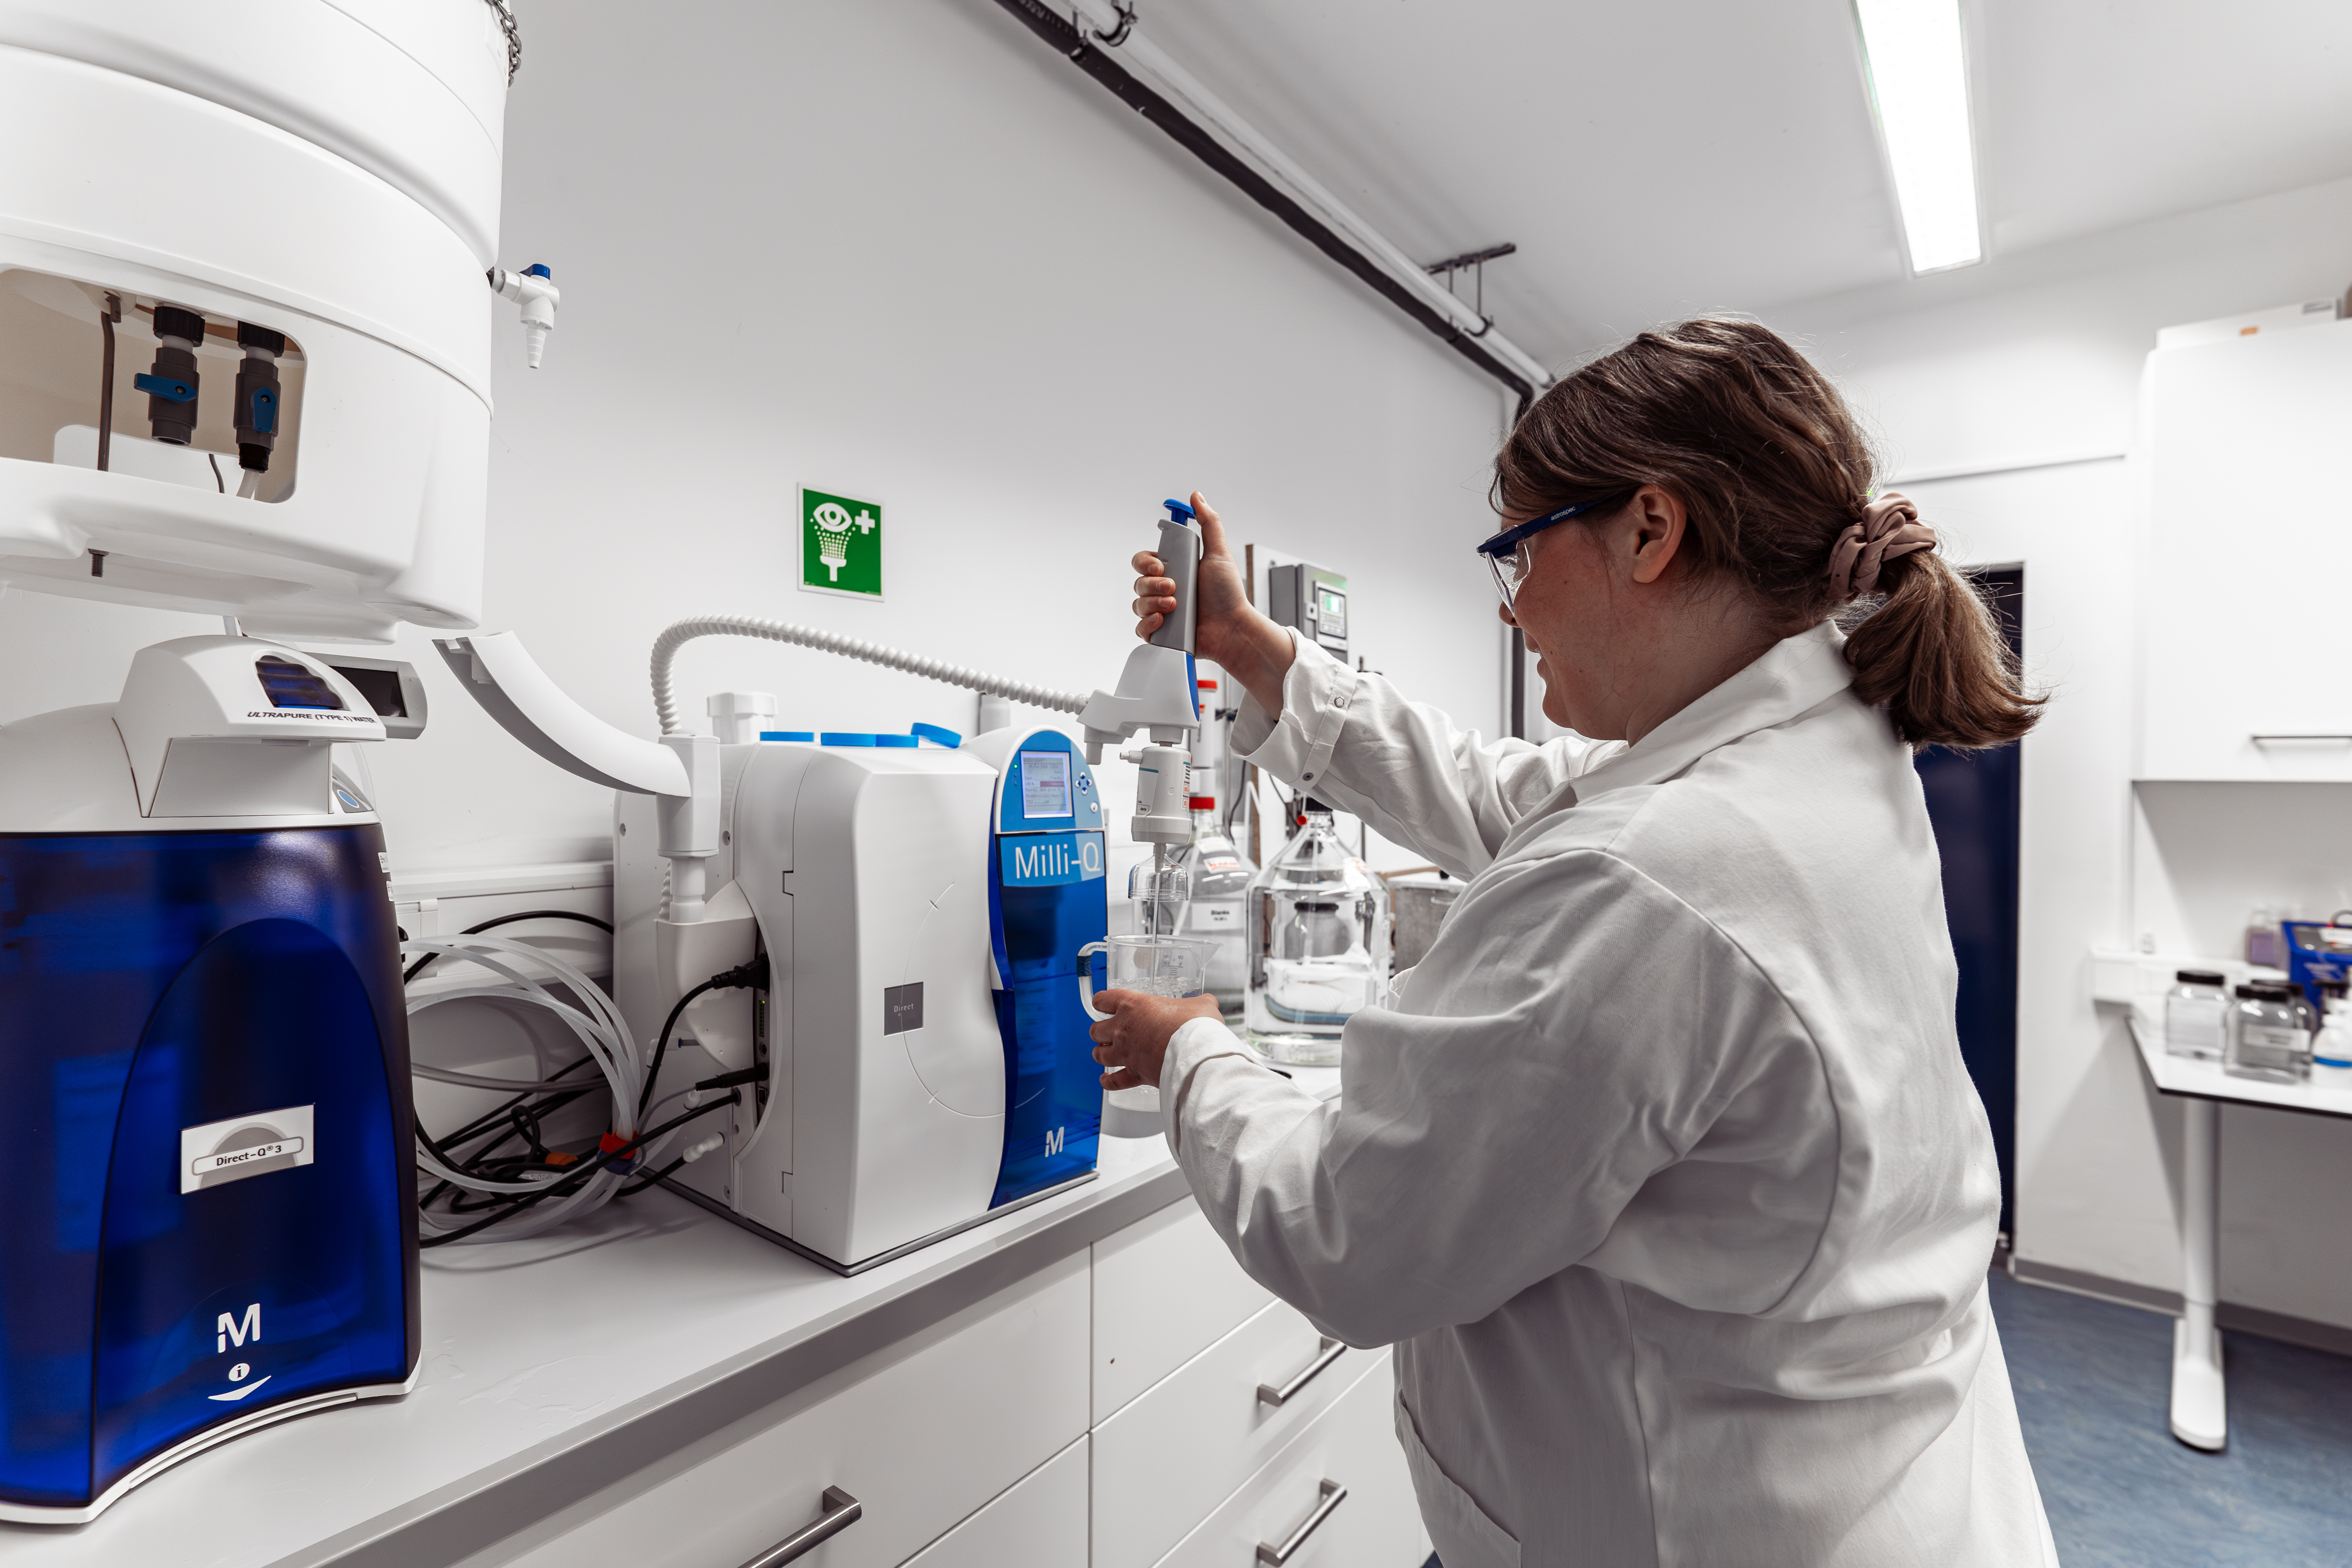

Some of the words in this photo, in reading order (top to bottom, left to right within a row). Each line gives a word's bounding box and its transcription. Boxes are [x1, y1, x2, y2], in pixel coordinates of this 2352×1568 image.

[1551, 506, 1576, 521] astrospec
[1015, 842, 1101, 878] Milli-Q
[894, 1003, 914, 1013] Direct
[1045, 1126, 1064, 1158] M
[218, 1303, 260, 1353] M
